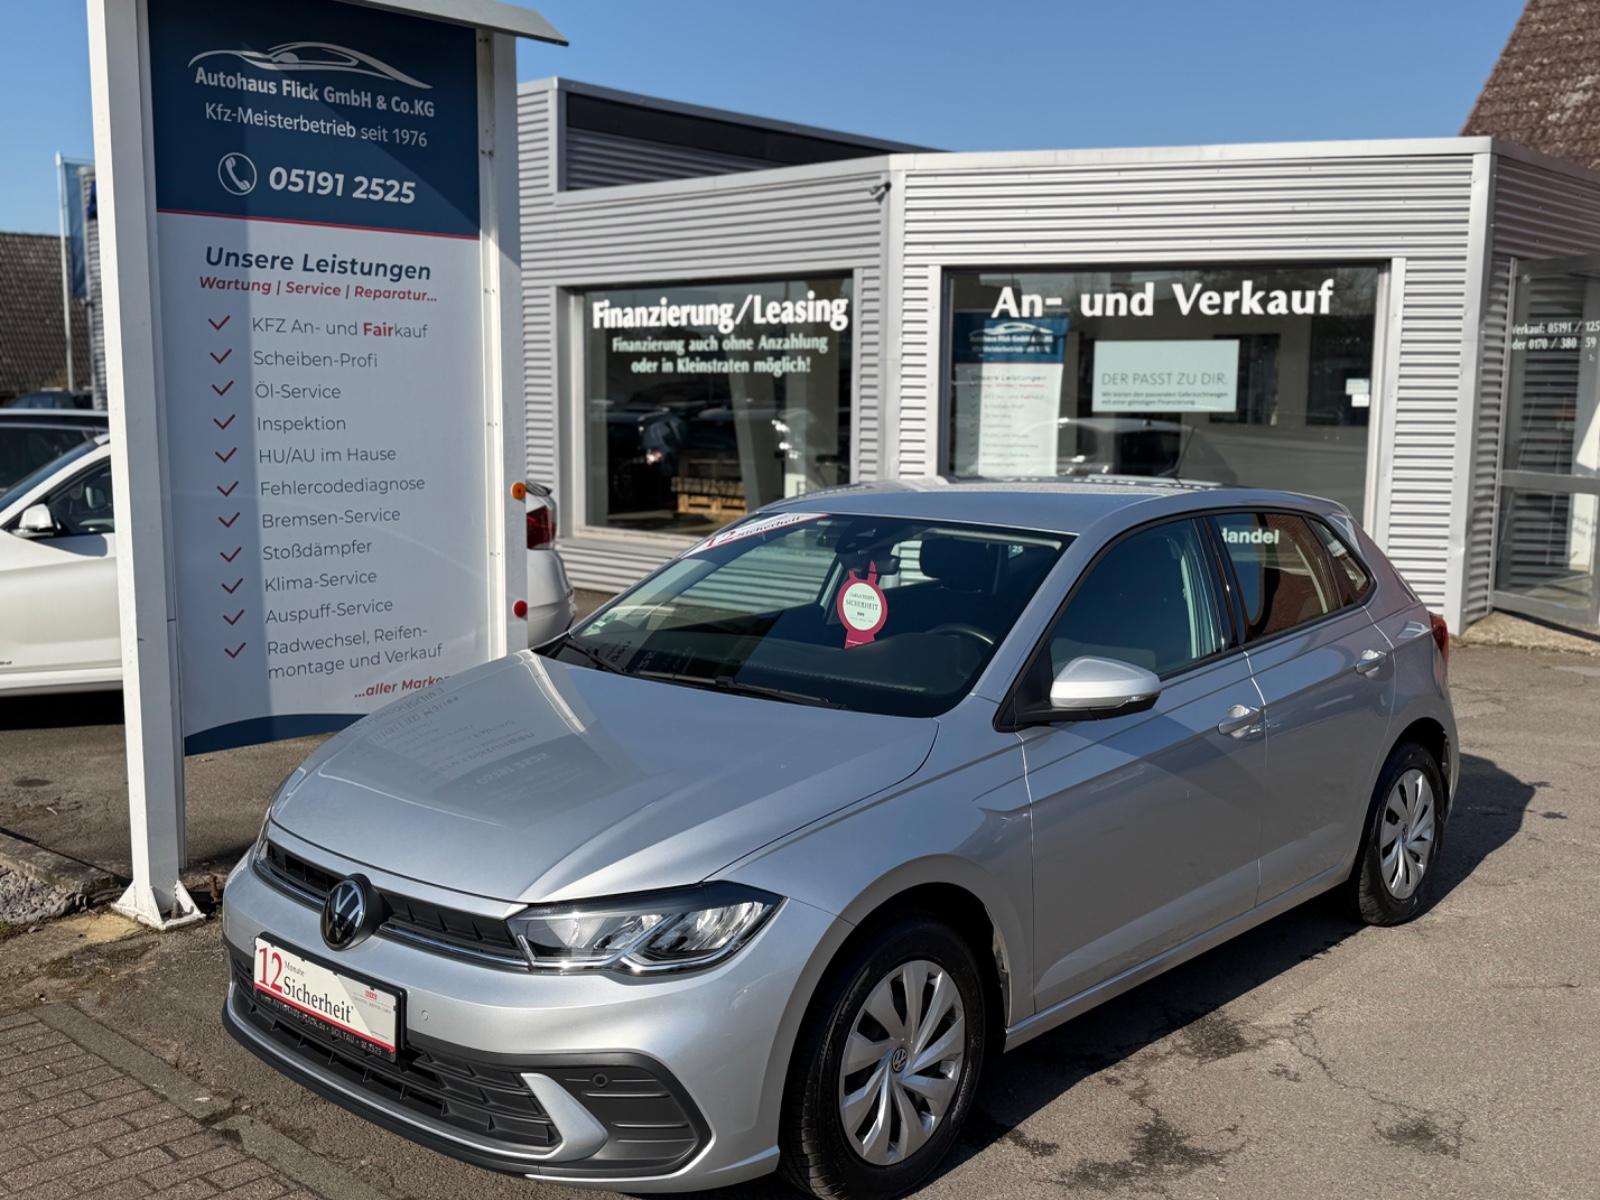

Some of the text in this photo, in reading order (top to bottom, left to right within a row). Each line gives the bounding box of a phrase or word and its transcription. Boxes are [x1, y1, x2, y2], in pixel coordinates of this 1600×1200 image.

[195, 67, 435, 118] Autohaus Flick GmbH & Co.KG
[205, 102, 428, 147] Kfz-Meisterbetrieb seit 1976
[269, 166, 416, 204] 05191 2525
[206, 246, 431, 282] Unsere Leistungen
[200, 276, 271, 295] Wartung
[286, 281, 341, 297] Service
[354, 285, 437, 302] Reparatur...
[991, 279, 1335, 318] An- und Verkauf
[592, 290, 848, 334] Finanzierung/Leasing
[252, 317, 428, 339] KFZ An- und Fairkauf
[1547, 321, 1572, 334] 05191
[612, 333, 828, 356] Finanzierung auch ohne Anzahlung
[1528, 338, 1549, 349] 0170
[253, 350, 378, 369] Scheiben-Profi
[631, 356, 811, 377] oder in Kleinstraten möglich!
[255, 380, 341, 399] Öl-Service
[1101, 372, 1128, 385] DER
[1132, 372, 1173, 385] PASST
[1177, 372, 1197, 385] ZU
[257, 415, 347, 434] Inspektion
[259, 446, 396, 465] HU/AU im Hause
[260, 477, 425, 496] Fehlercodediagnose
[262, 507, 401, 529] Bremsen-Service
[263, 538, 373, 560] Stoßdämpfer
[264, 570, 377, 592] Klima-Service
[264, 599, 393, 624] Auspuff-Service
[267, 624, 428, 656] Radwechsel, Reifen-
[267, 643, 443, 680] montage und Verkauf
[354, 682, 398, 698] ...aller
[258, 947, 283, 993] 12
[283, 976, 352, 1024] Sicherheit
